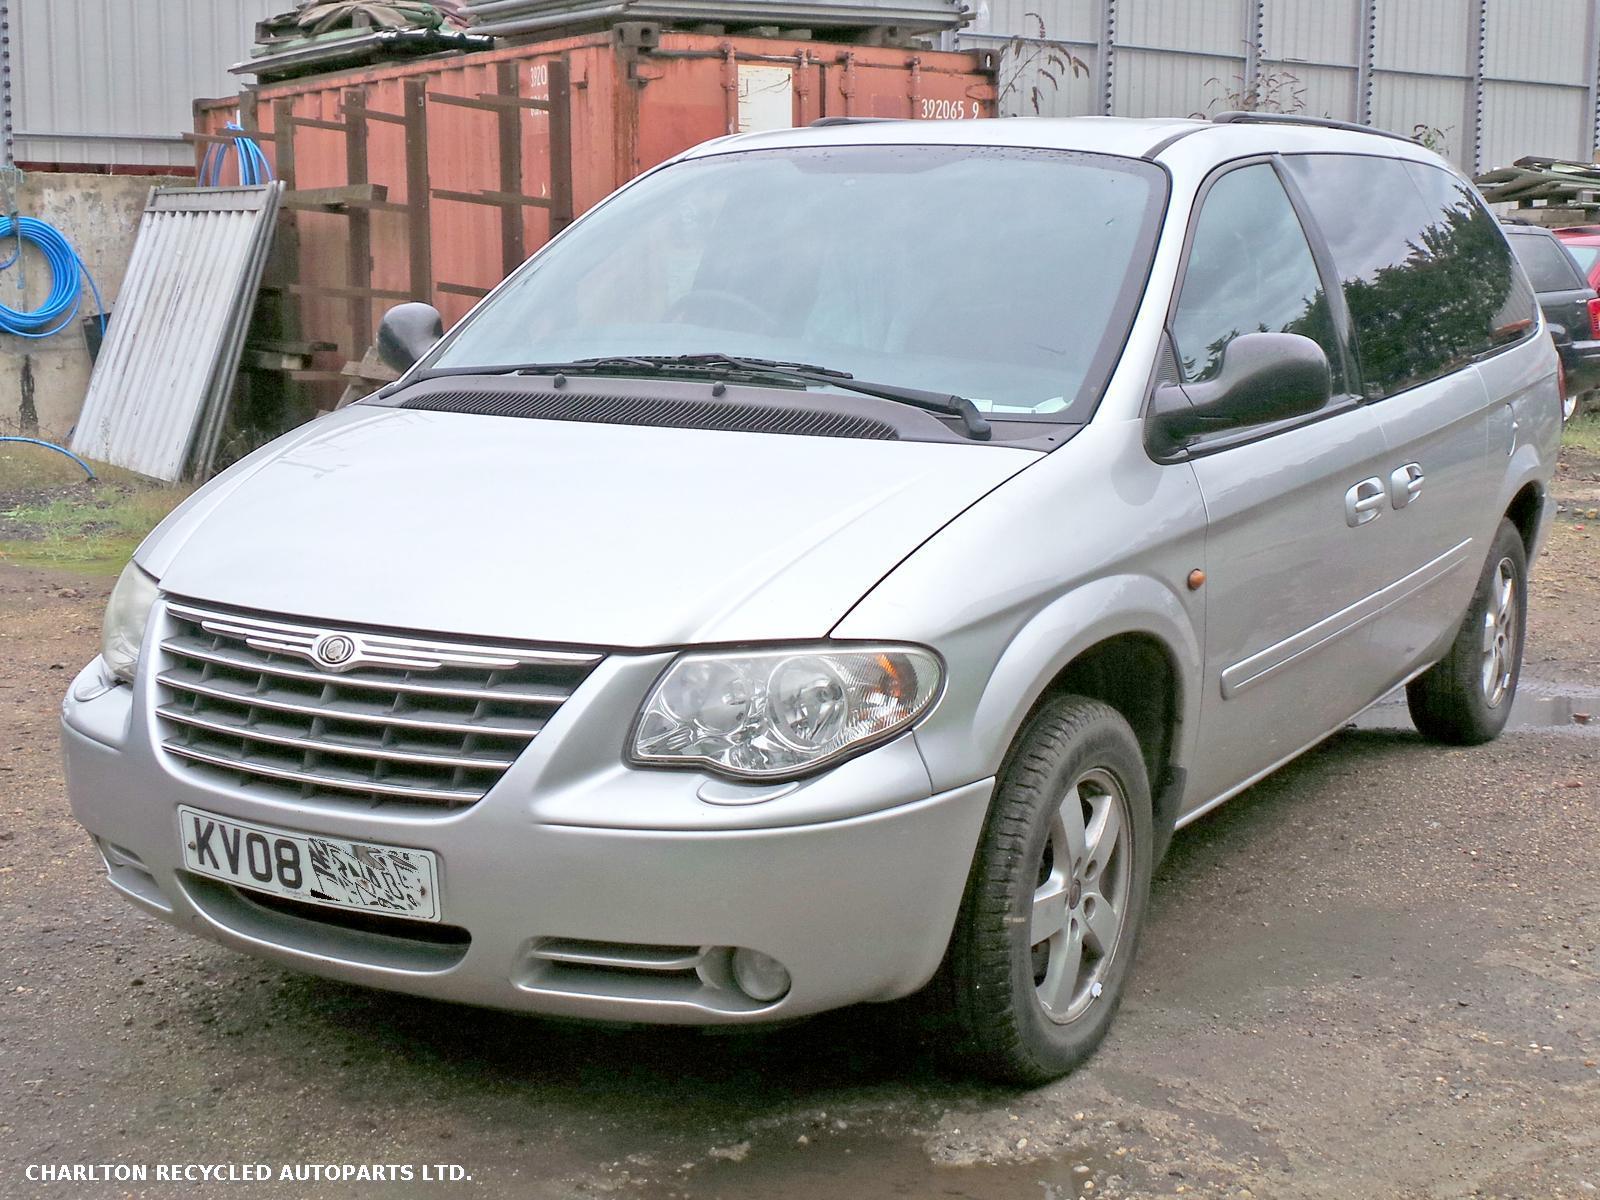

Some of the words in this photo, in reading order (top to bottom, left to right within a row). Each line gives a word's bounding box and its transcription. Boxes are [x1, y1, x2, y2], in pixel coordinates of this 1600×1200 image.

[921, 98, 965, 120] 392065
[972, 101, 980, 120] 9
[193, 816, 303, 890] KV08
